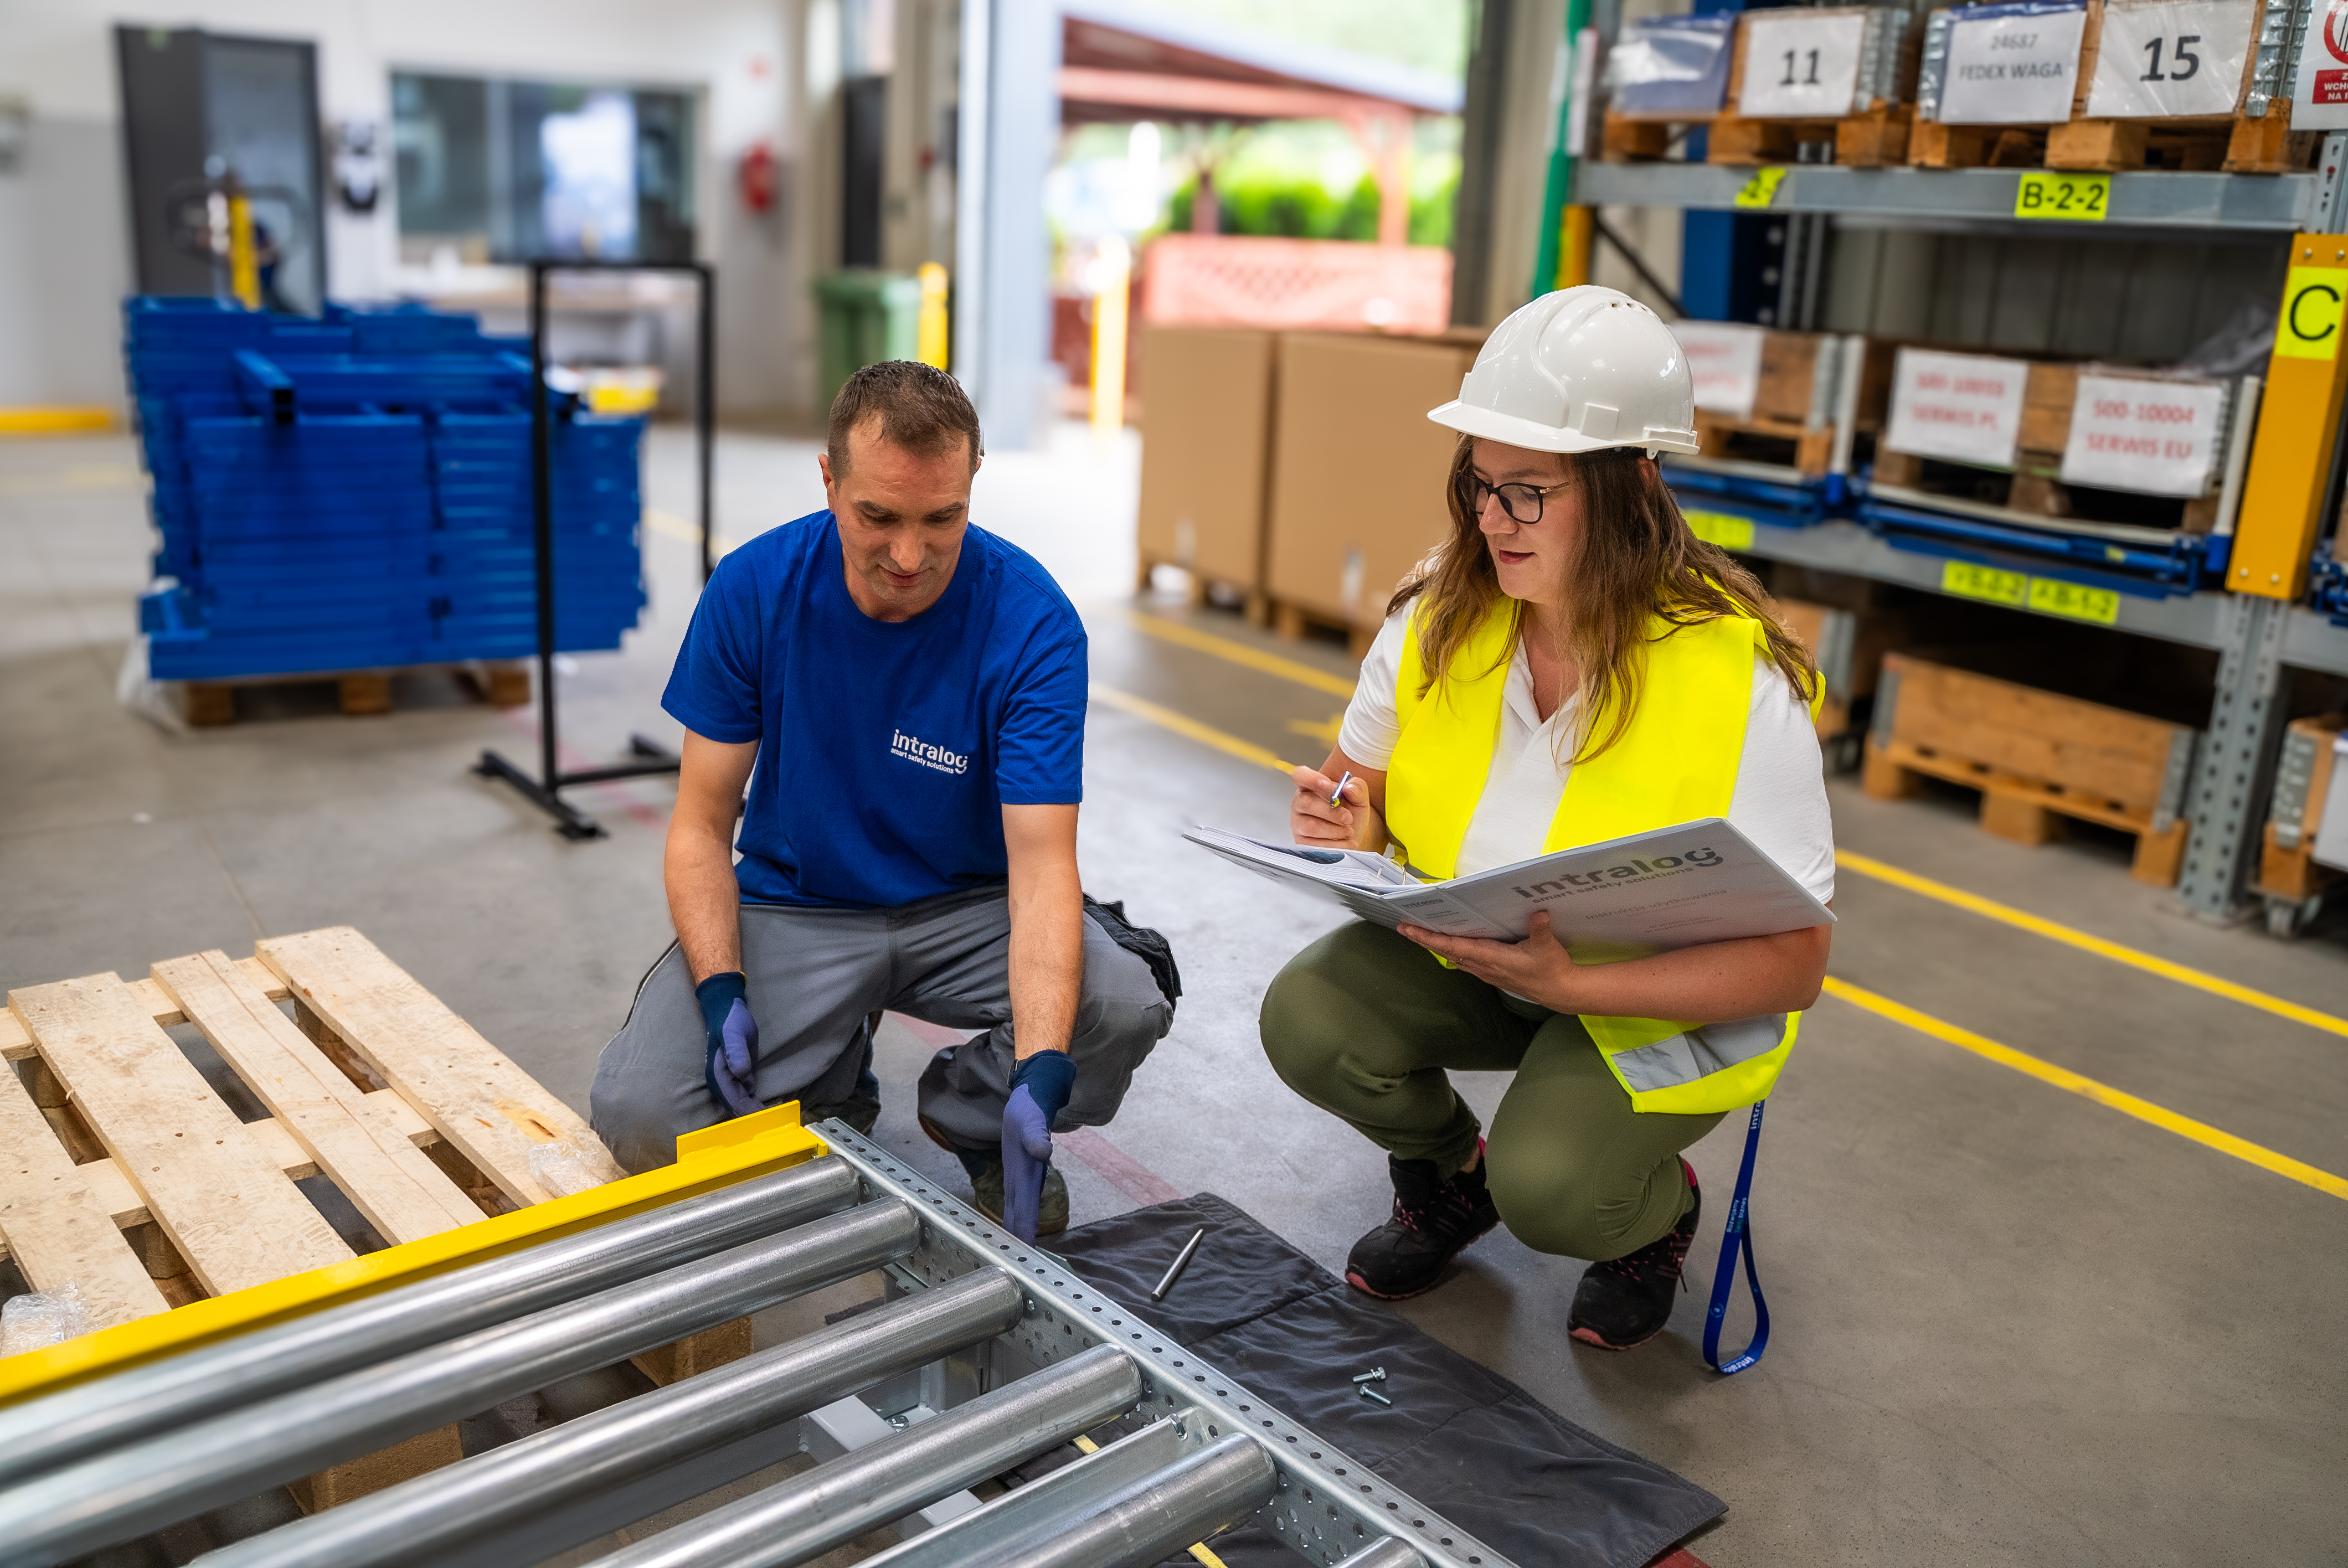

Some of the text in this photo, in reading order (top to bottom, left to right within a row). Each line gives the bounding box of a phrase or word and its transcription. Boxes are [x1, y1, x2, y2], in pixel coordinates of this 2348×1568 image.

[1779, 48, 1820, 86] 11
[1959, 62, 2063, 81] FEDEX WAGA
[2140, 35, 2201, 82] 15
[2324, 82, 2348, 91] WCH
[2328, 92, 2342, 100] NA
[2022, 182, 2104, 213] B-2-2
[2289, 285, 2340, 341] C
[2087, 432, 2193, 460] SERWIS EU
[890, 747, 954, 774] smart safety solutions
[892, 729, 968, 775] intralog
[1512, 847, 1724, 899] intralog
[1532, 866, 1694, 904] smart safety solutions
[1402, 898, 1444, 909] intralog
